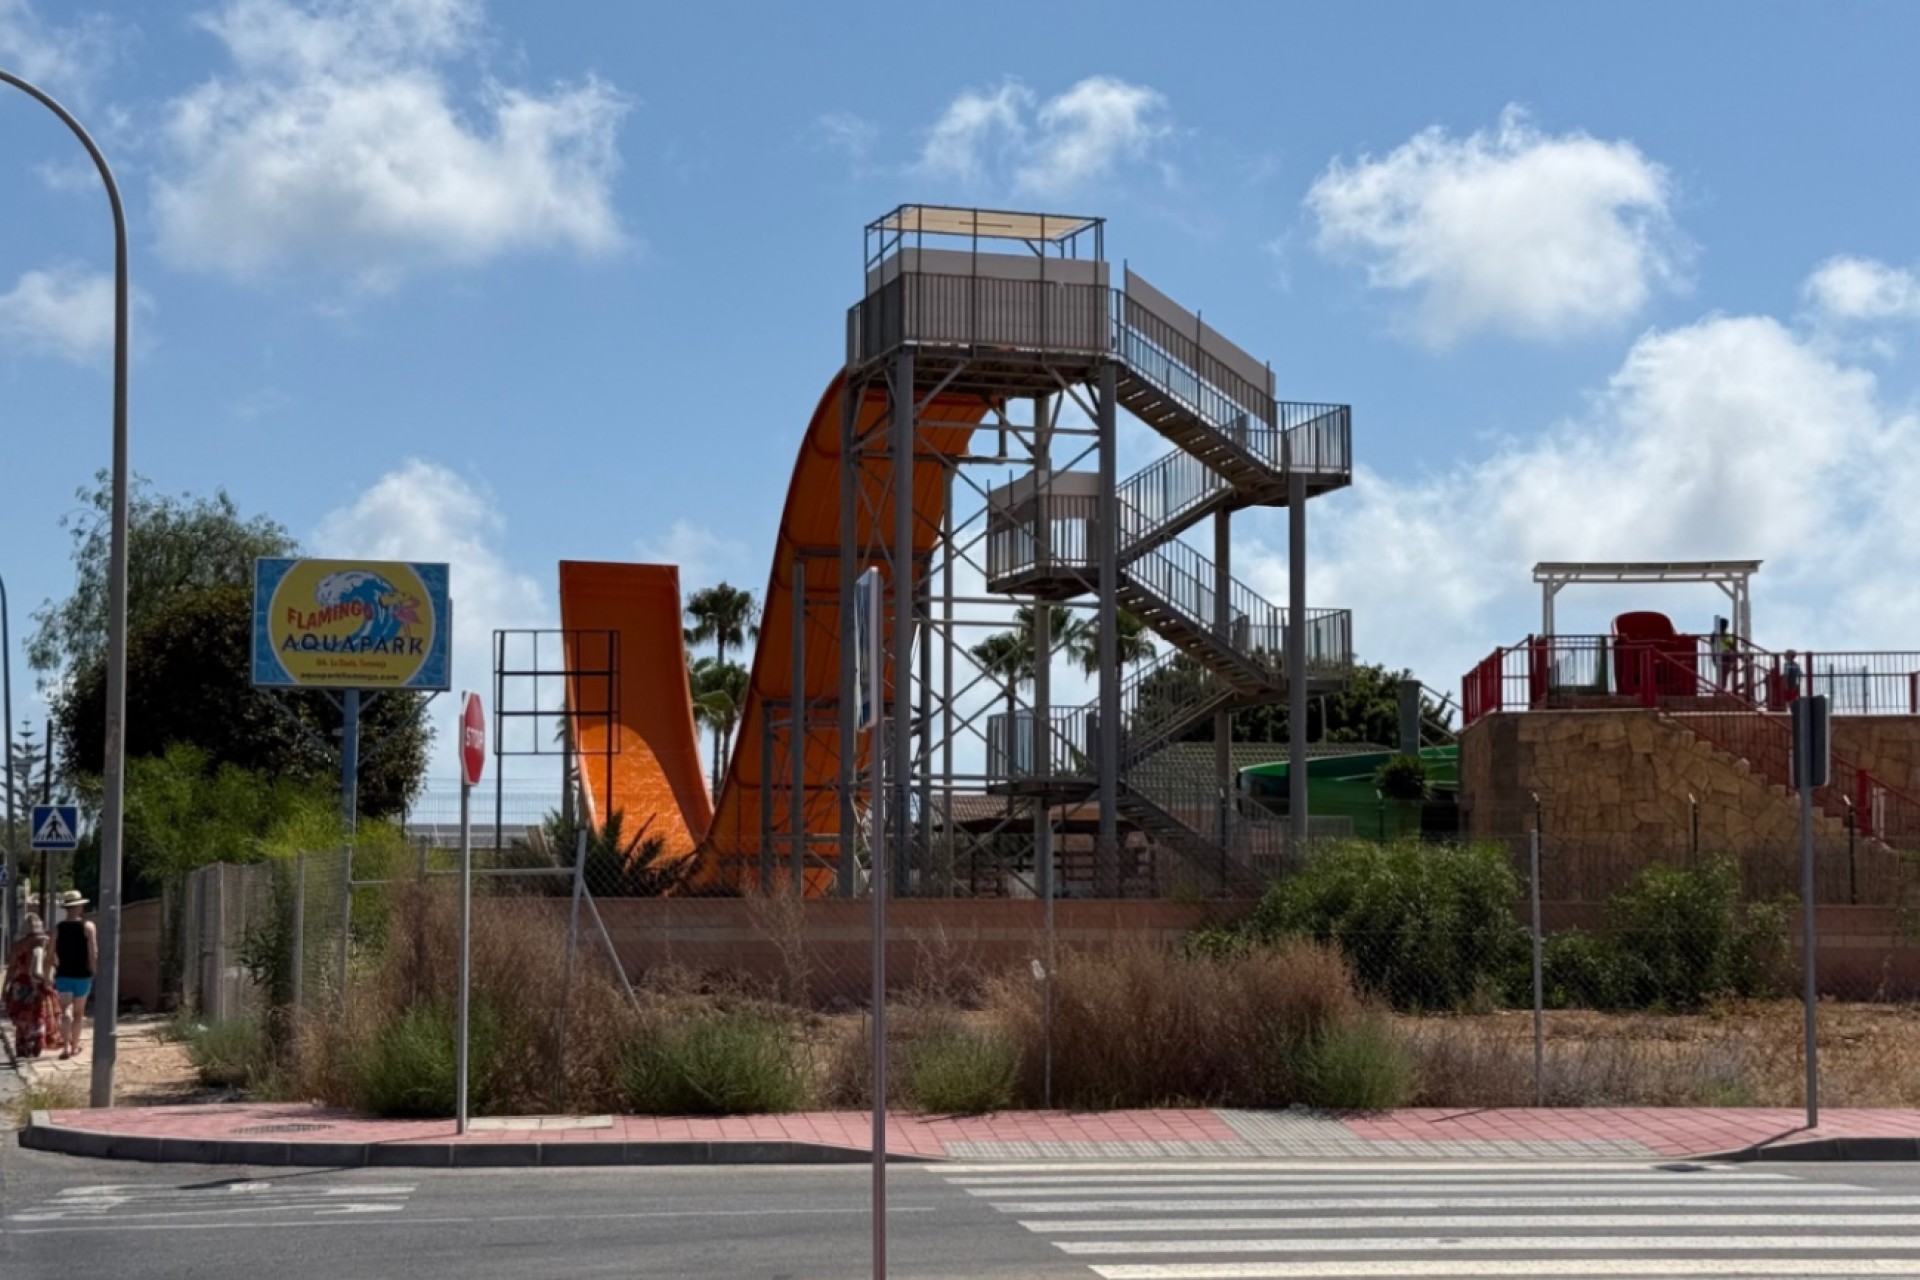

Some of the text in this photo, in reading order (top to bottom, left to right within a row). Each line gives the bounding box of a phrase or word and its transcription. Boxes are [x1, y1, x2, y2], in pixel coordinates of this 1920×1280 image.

[287, 600, 373, 631] FLAMINGO
[282, 633, 423, 655] AQUAPARK
[466, 726, 484, 752] STOP
